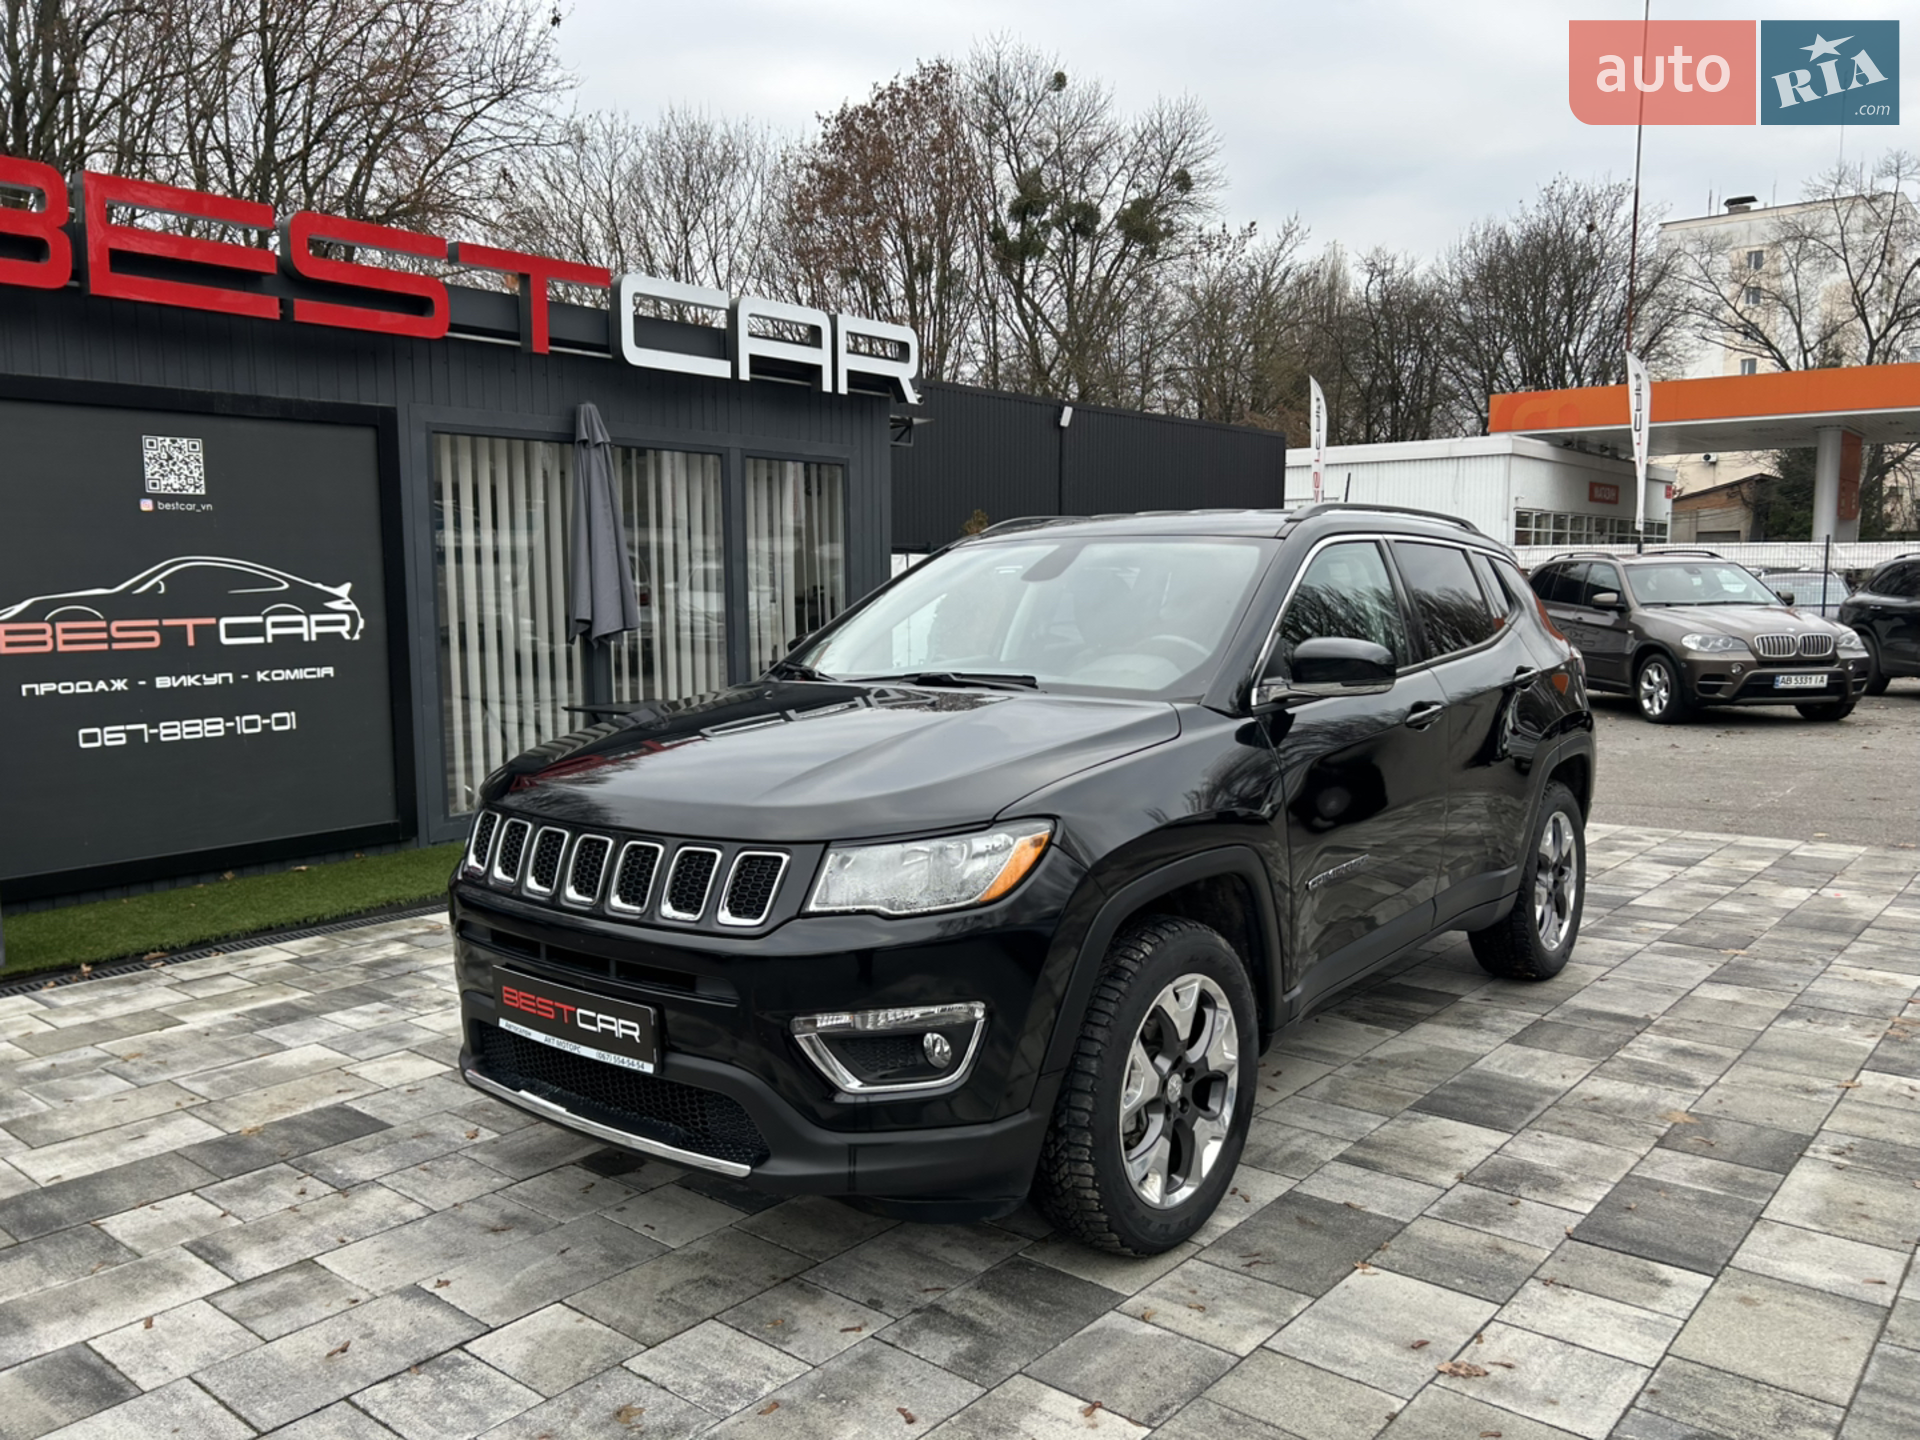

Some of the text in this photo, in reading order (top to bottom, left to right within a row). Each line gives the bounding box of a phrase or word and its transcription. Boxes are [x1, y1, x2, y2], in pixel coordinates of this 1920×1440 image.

[157, 501, 213, 512] bestcar_vn
[0, 613, 352, 655] BESTCAR
[21, 678, 128, 696] ПРОДАЖ
[155, 672, 234, 689] ВИКУП
[256, 666, 334, 683] КОМІСІЯ
[78, 711, 297, 749] 067-888-10-01
[502, 985, 641, 1043] BESTCAR
